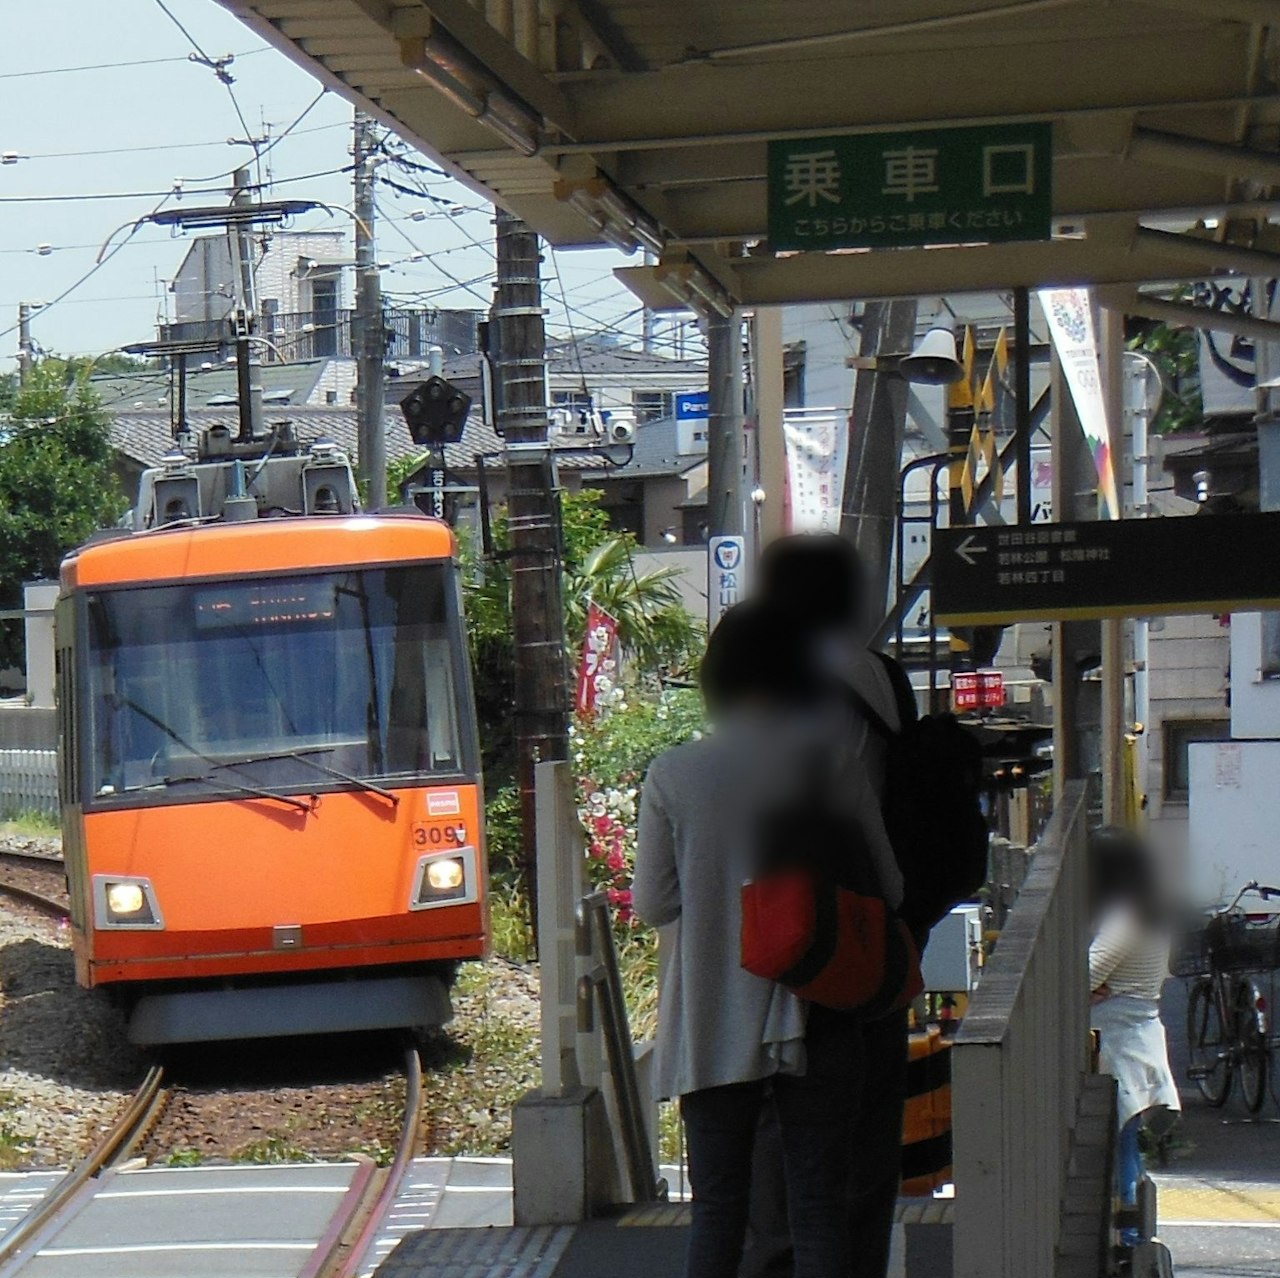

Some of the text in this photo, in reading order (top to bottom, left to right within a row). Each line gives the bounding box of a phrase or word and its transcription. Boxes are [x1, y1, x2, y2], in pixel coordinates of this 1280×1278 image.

[784, 144, 1035, 207] 乗車口
[794, 210, 1023, 237] こちらからご乗車ください
